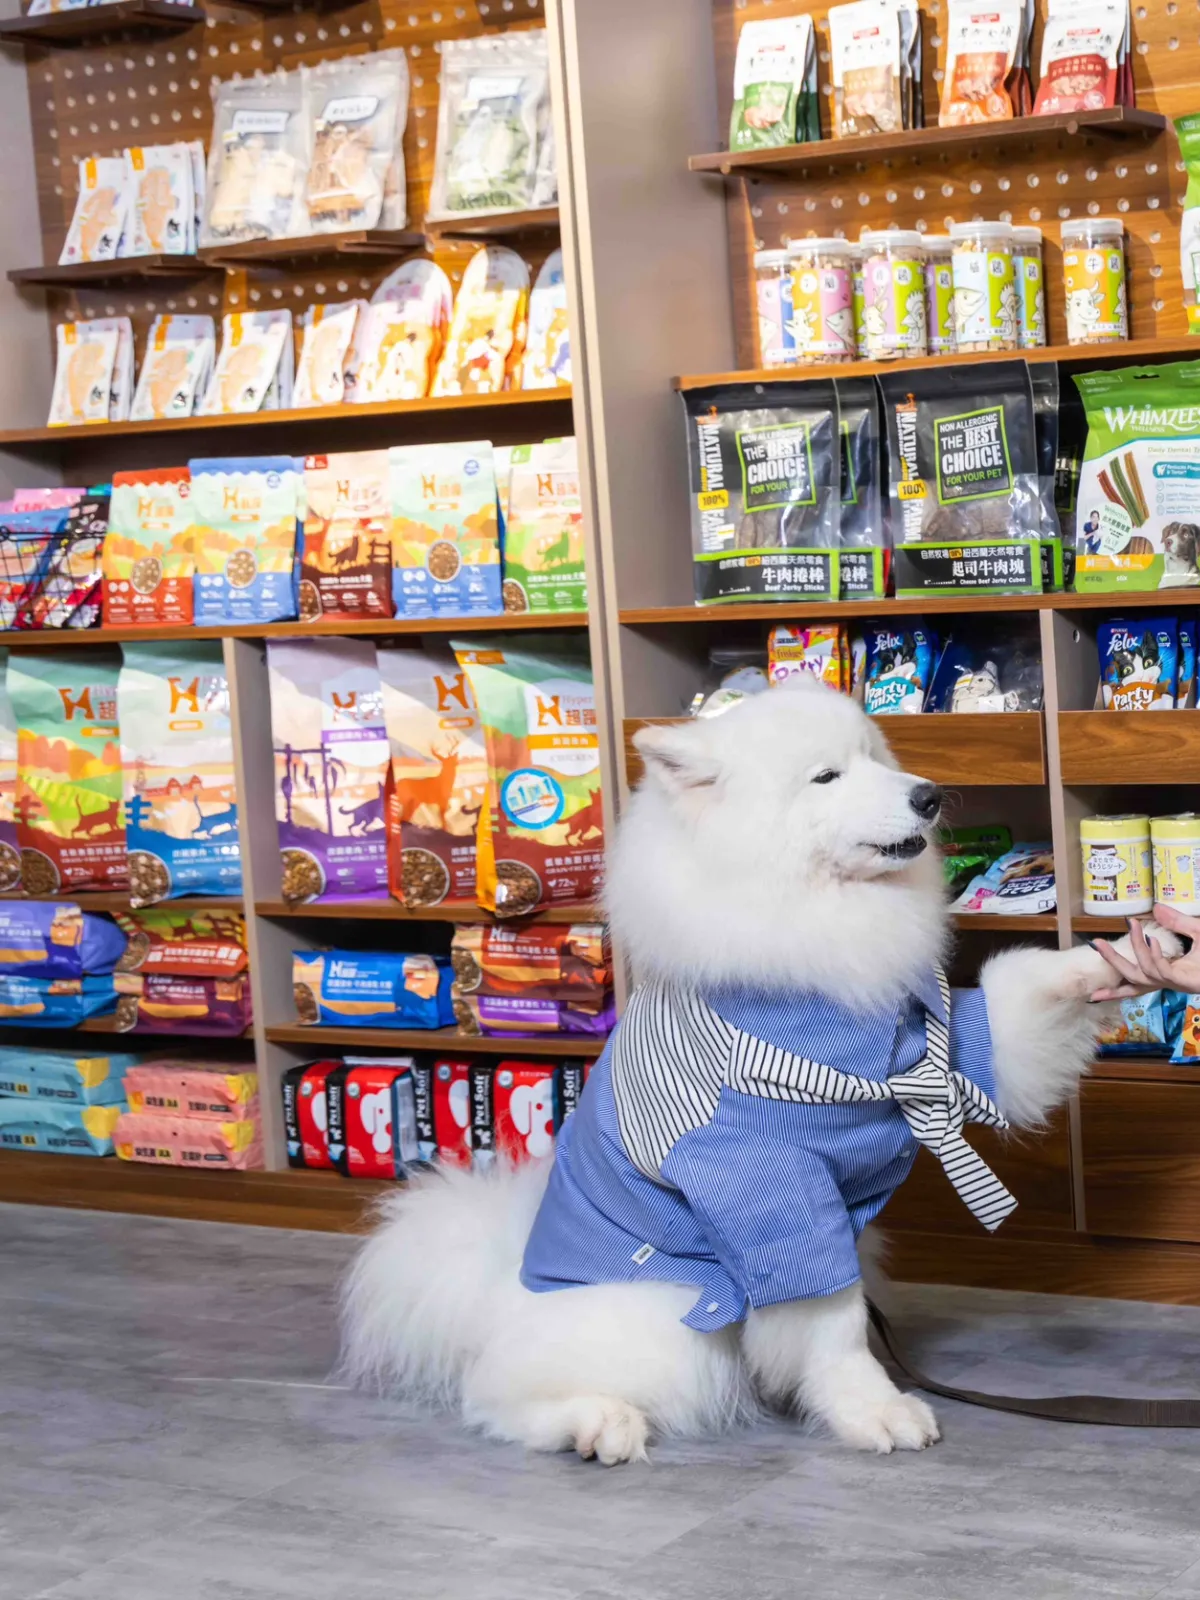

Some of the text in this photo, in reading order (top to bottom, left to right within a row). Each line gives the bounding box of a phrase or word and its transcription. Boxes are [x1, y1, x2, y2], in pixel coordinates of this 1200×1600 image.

[940, 413, 998, 433] NON ALLERGENIC
[902, 412, 919, 481] NATURAL
[941, 423, 998, 450] THE BEST
[744, 436, 803, 461] THE BEST
[942, 445, 1003, 475] CHOICE
[747, 457, 806, 485] CHOICE
[946, 468, 1002, 486] FOR YOUR PET
[750, 480, 788, 495] FOR YOUR
[902, 482, 925, 495] 100%
[702, 494, 726, 505] 100%
[952, 559, 1025, 577] 起司牛肉塊
[765, 584, 780, 592] Beef
[782, 584, 802, 592] Jerky
[991, 577, 1006, 585] Jerky
[872, 633, 902, 654] felix
[1106, 632, 1141, 656] felix
[868, 680, 907, 703] party
[871, 692, 897, 711] mix
[1113, 686, 1154, 709] party
[565, 1067, 577, 1094] Soft
[329, 1086, 339, 1126] Pet Soft
[417, 1069, 428, 1120] Pet Soft
[475, 1074, 486, 1126] Pet Soft
